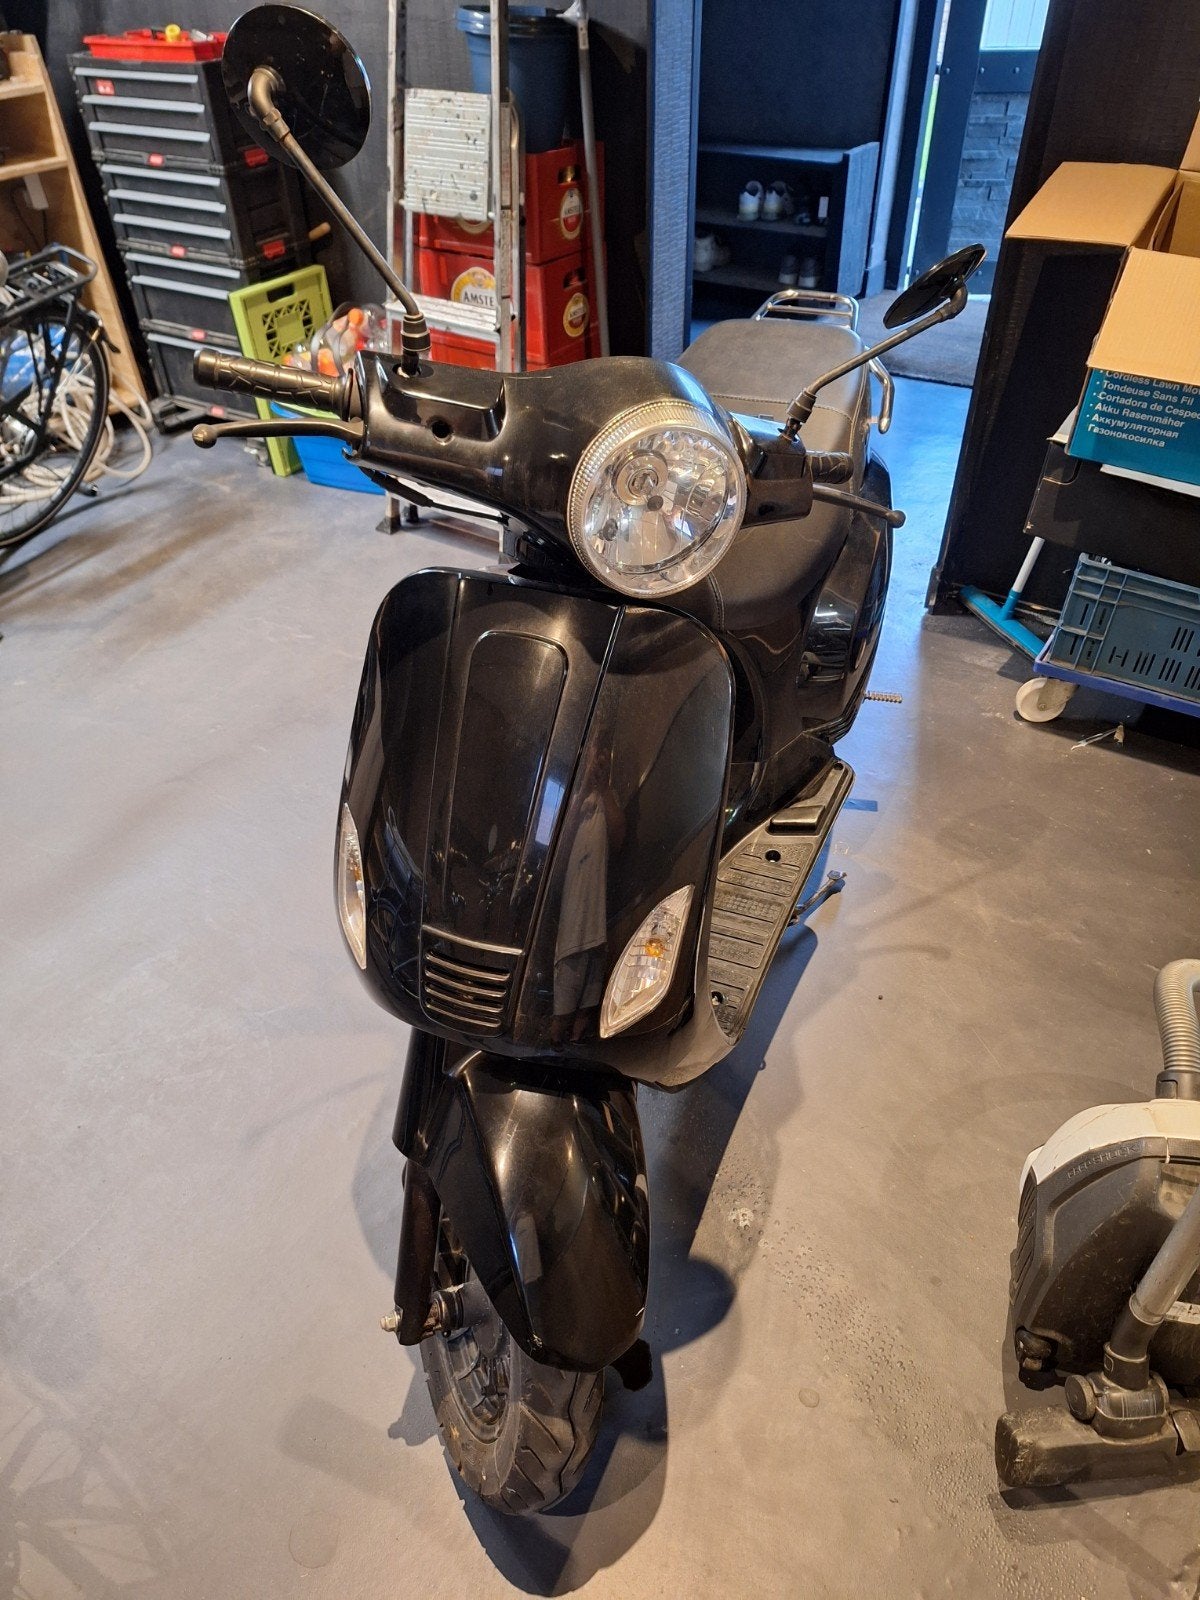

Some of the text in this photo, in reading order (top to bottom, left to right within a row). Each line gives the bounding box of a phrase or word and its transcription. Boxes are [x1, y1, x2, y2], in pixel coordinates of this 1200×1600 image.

[463, 290, 494, 307] AMSTE
[1103, 379, 1195, 406] Tondeuse Sans Fil
[1105, 370, 1150, 386] Cordless
[1152, 379, 1180, 391] Lawn
[1097, 391, 1148, 409] Cortadora
[1150, 402, 1163, 412] de
[1091, 413, 1179, 439] Аккумуляторная
[1094, 402, 1185, 428] Akku Rasenmäher
[1088, 424, 1166, 448] Газонокосилка
